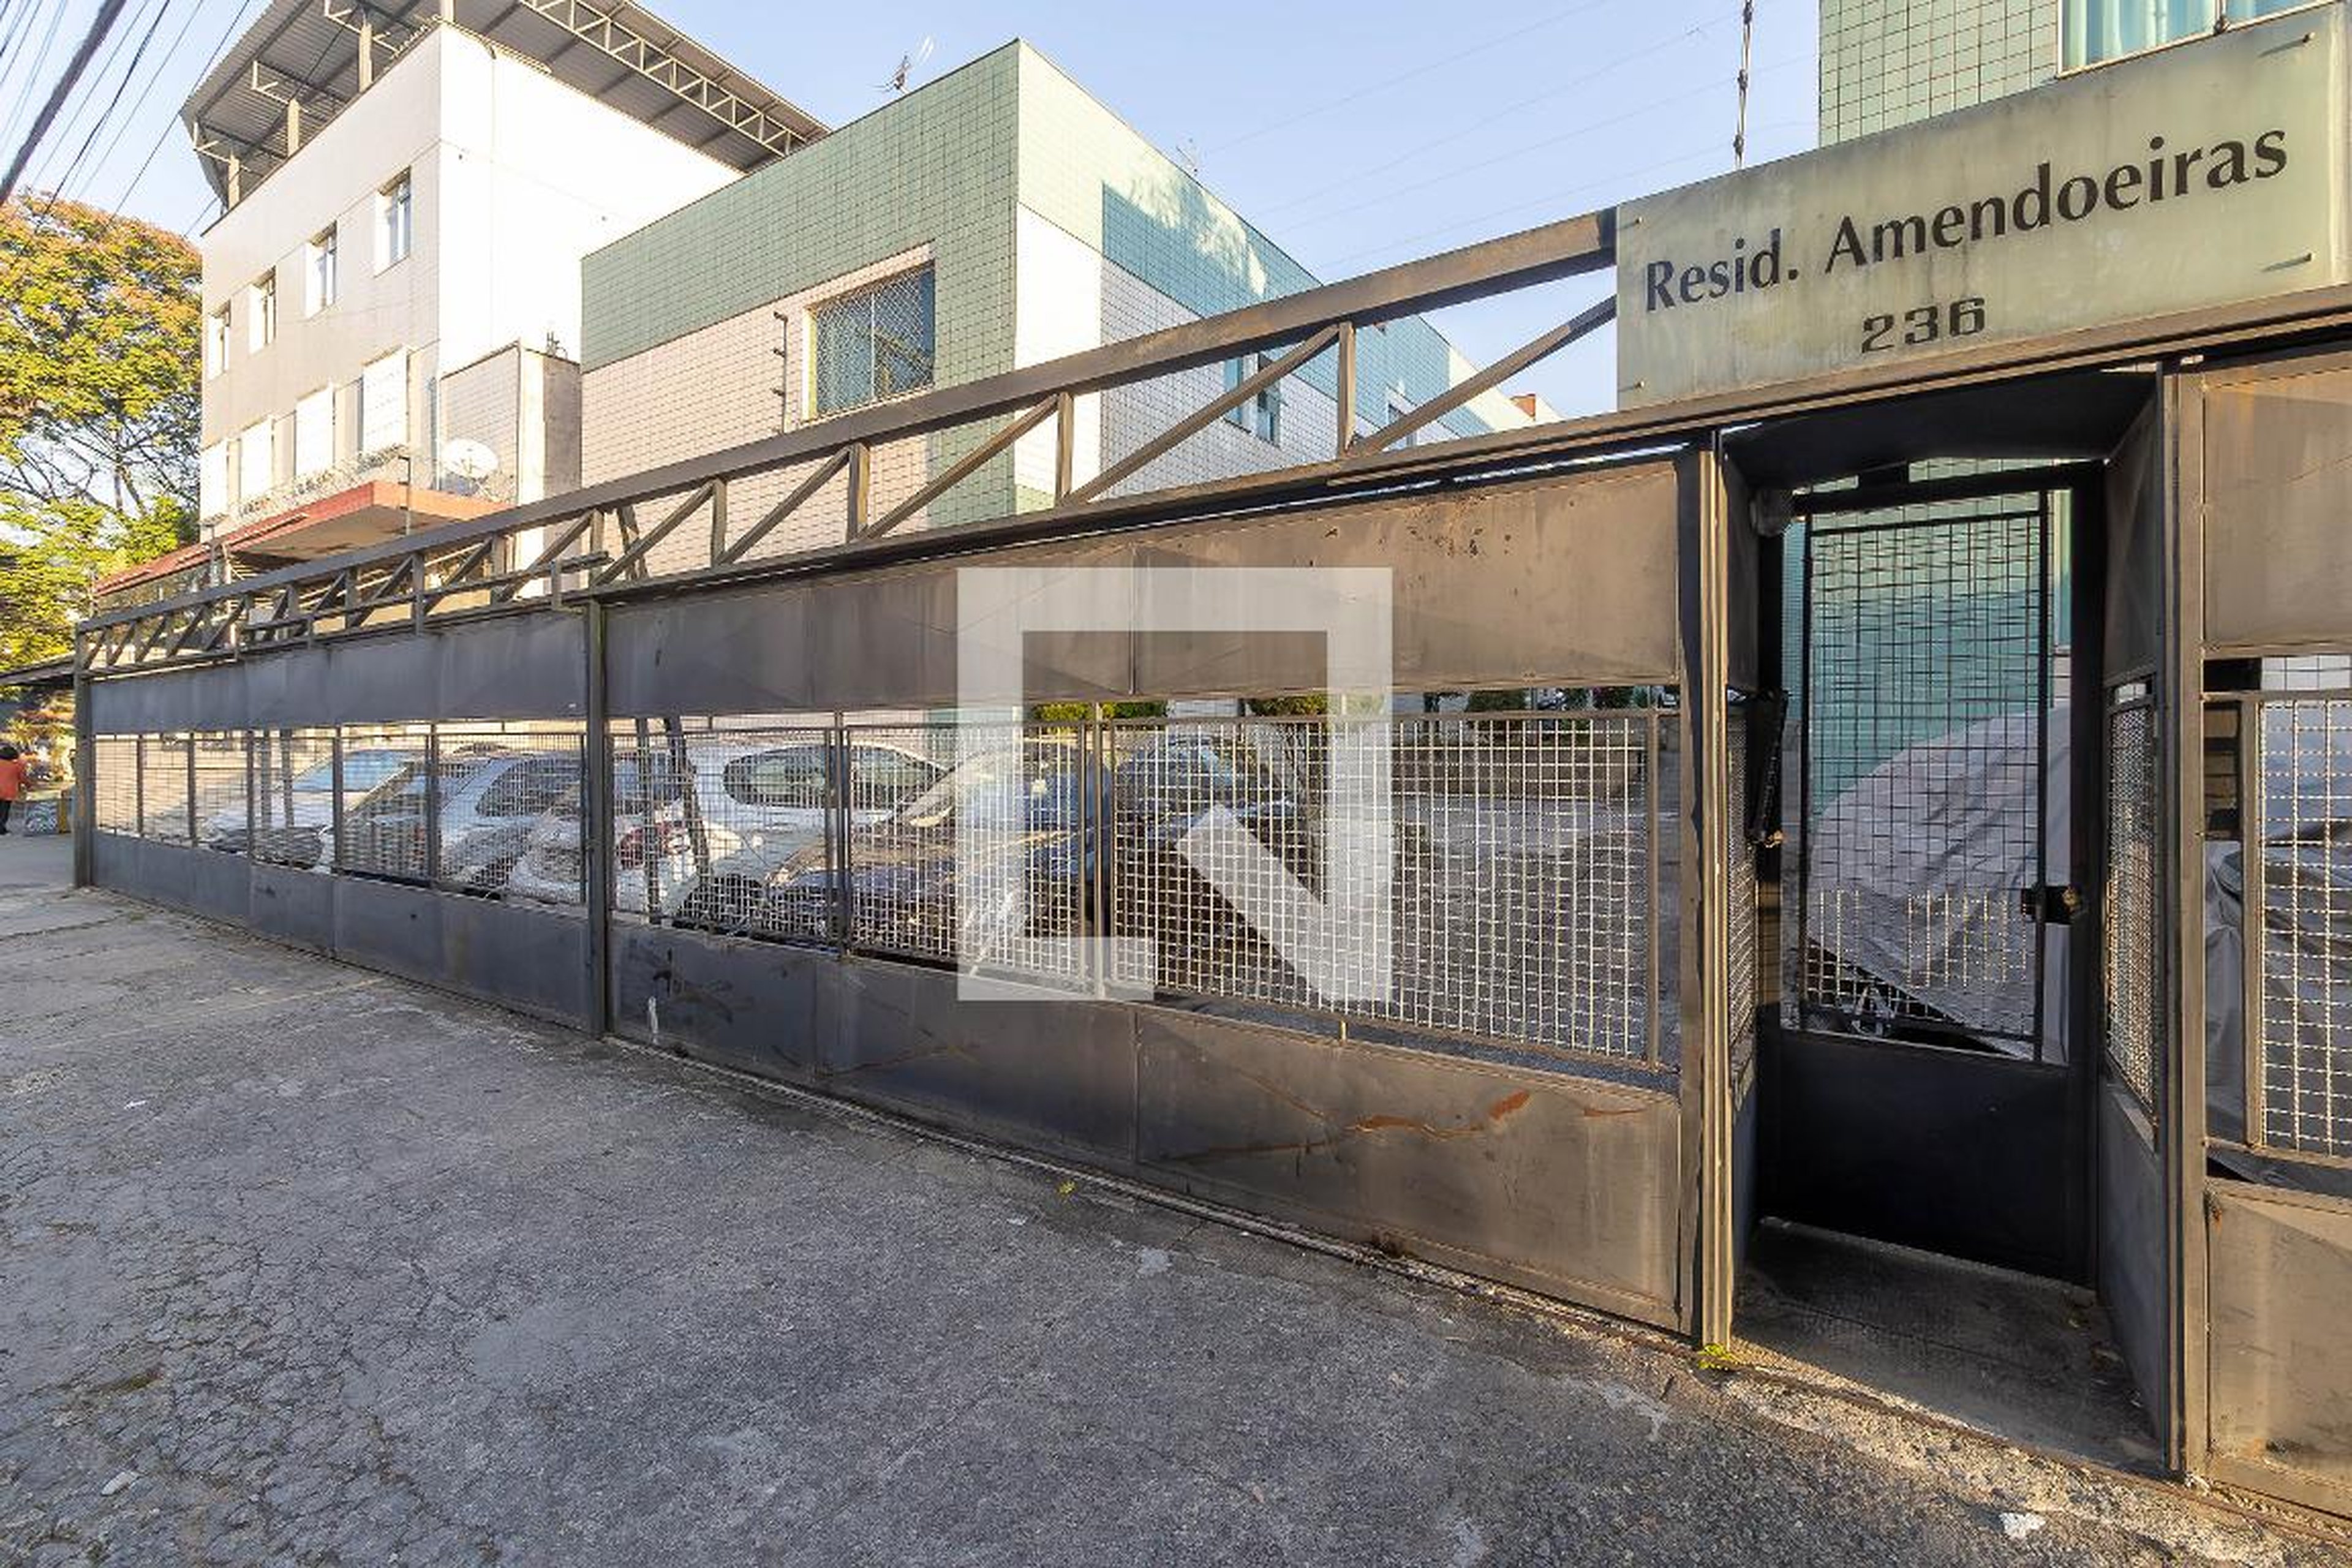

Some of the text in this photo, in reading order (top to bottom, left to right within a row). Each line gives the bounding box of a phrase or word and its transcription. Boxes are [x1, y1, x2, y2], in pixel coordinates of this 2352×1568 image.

[1646, 129, 2288, 312] Resid. Amendoeiras
[1861, 296, 1986, 354] 236
